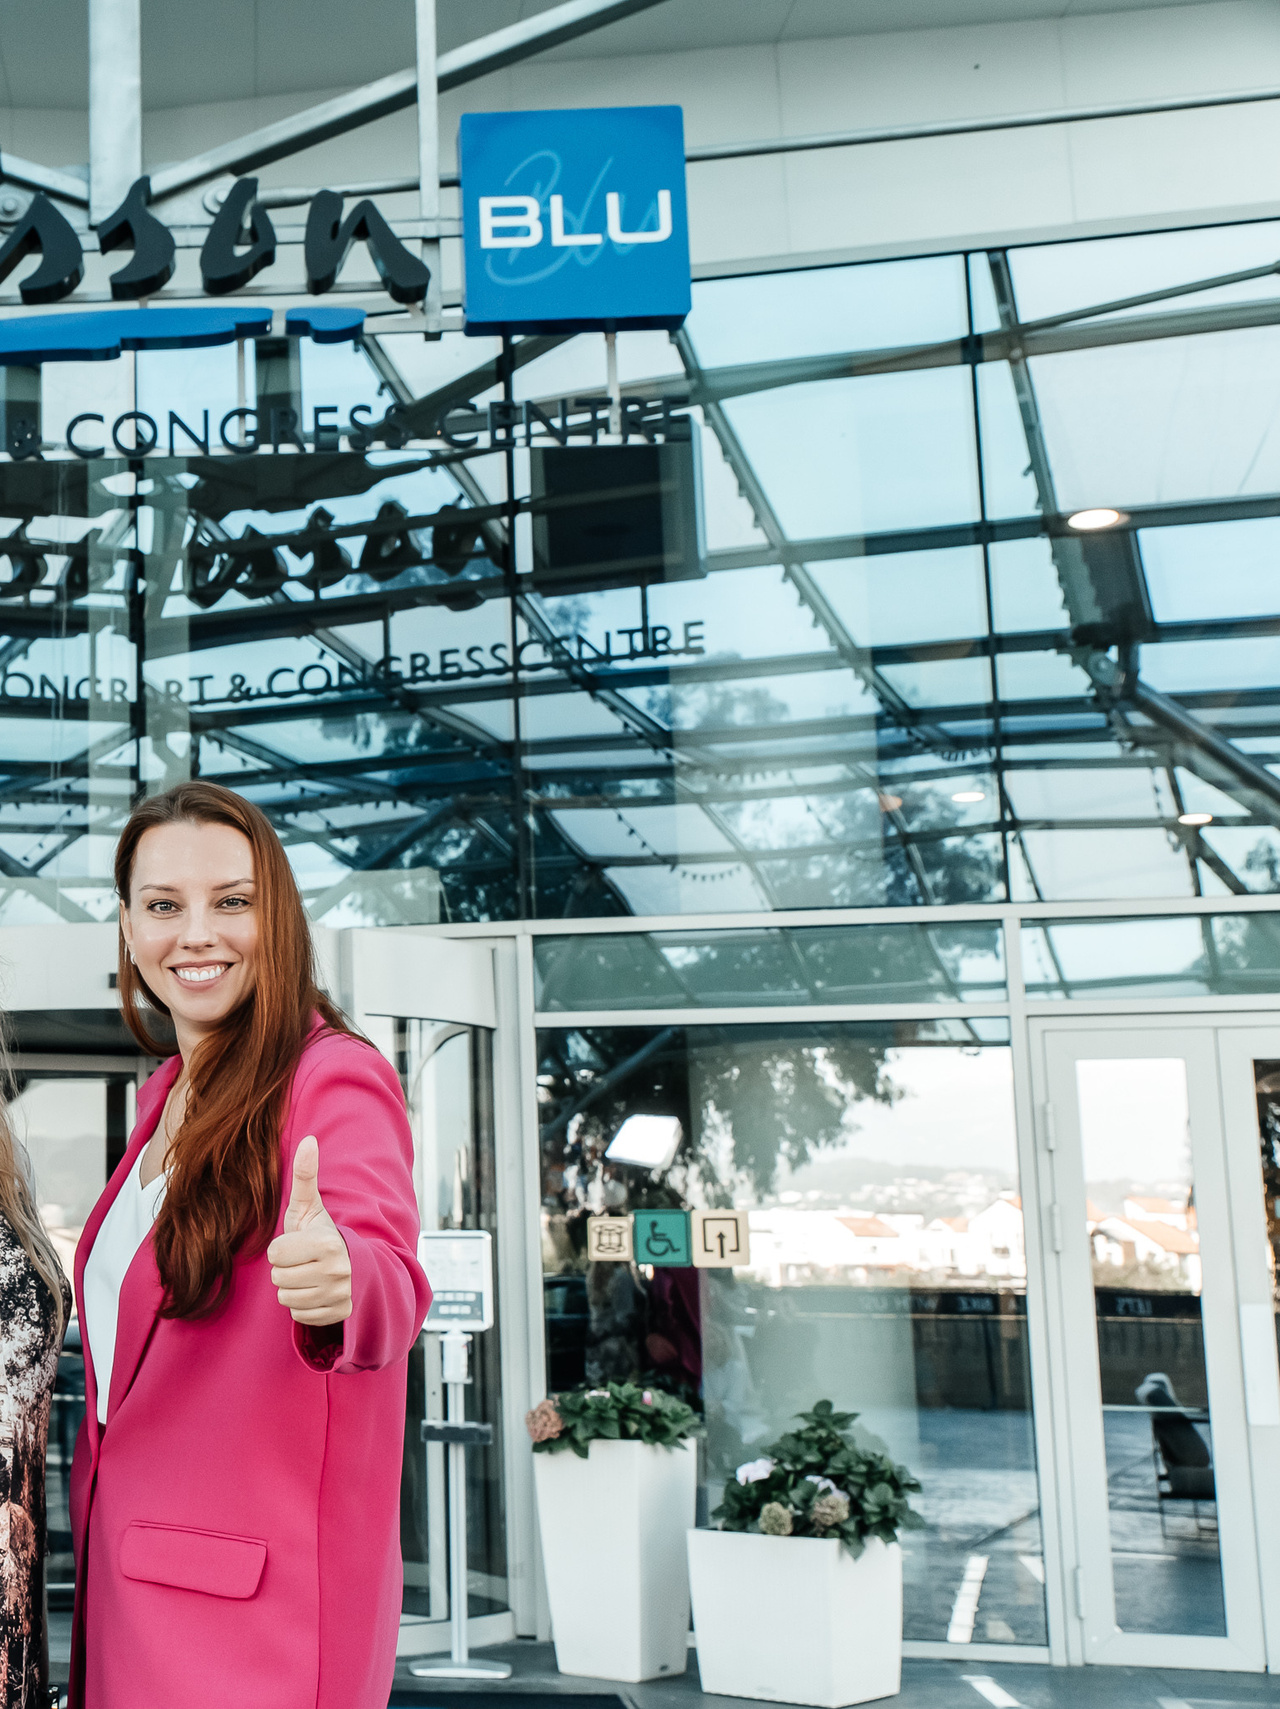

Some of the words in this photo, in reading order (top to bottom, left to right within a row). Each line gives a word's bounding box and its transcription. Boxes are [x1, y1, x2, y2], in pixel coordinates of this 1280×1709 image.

[479, 189, 673, 249] BLU
[66, 404, 411, 459] CONGRESS
[438, 396, 692, 448] CENTRE
